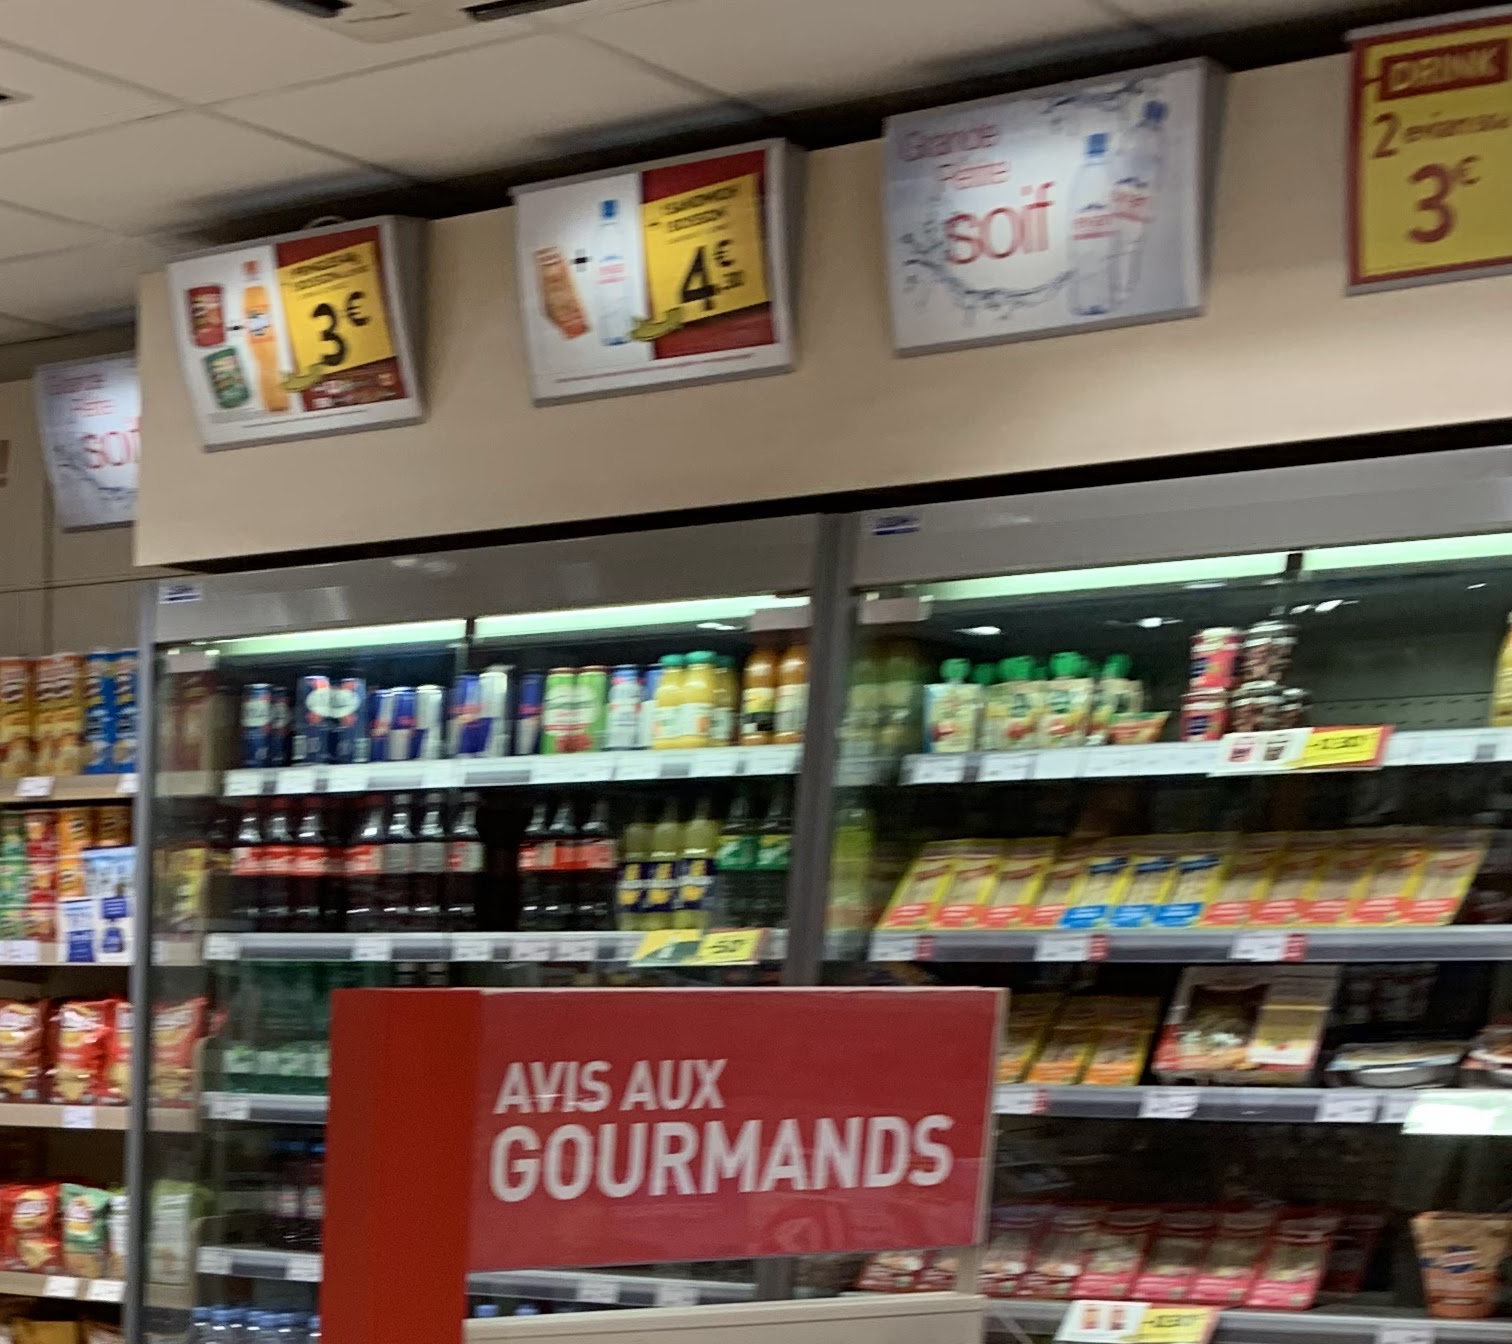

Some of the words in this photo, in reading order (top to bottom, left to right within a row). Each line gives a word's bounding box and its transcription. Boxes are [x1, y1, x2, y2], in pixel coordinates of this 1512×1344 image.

[944, 181, 1058, 265] soif
[492, 1060, 613, 1115] AVIS
[619, 1057, 729, 1112] AUX
[489, 1113, 957, 1203] GOURMANDS
